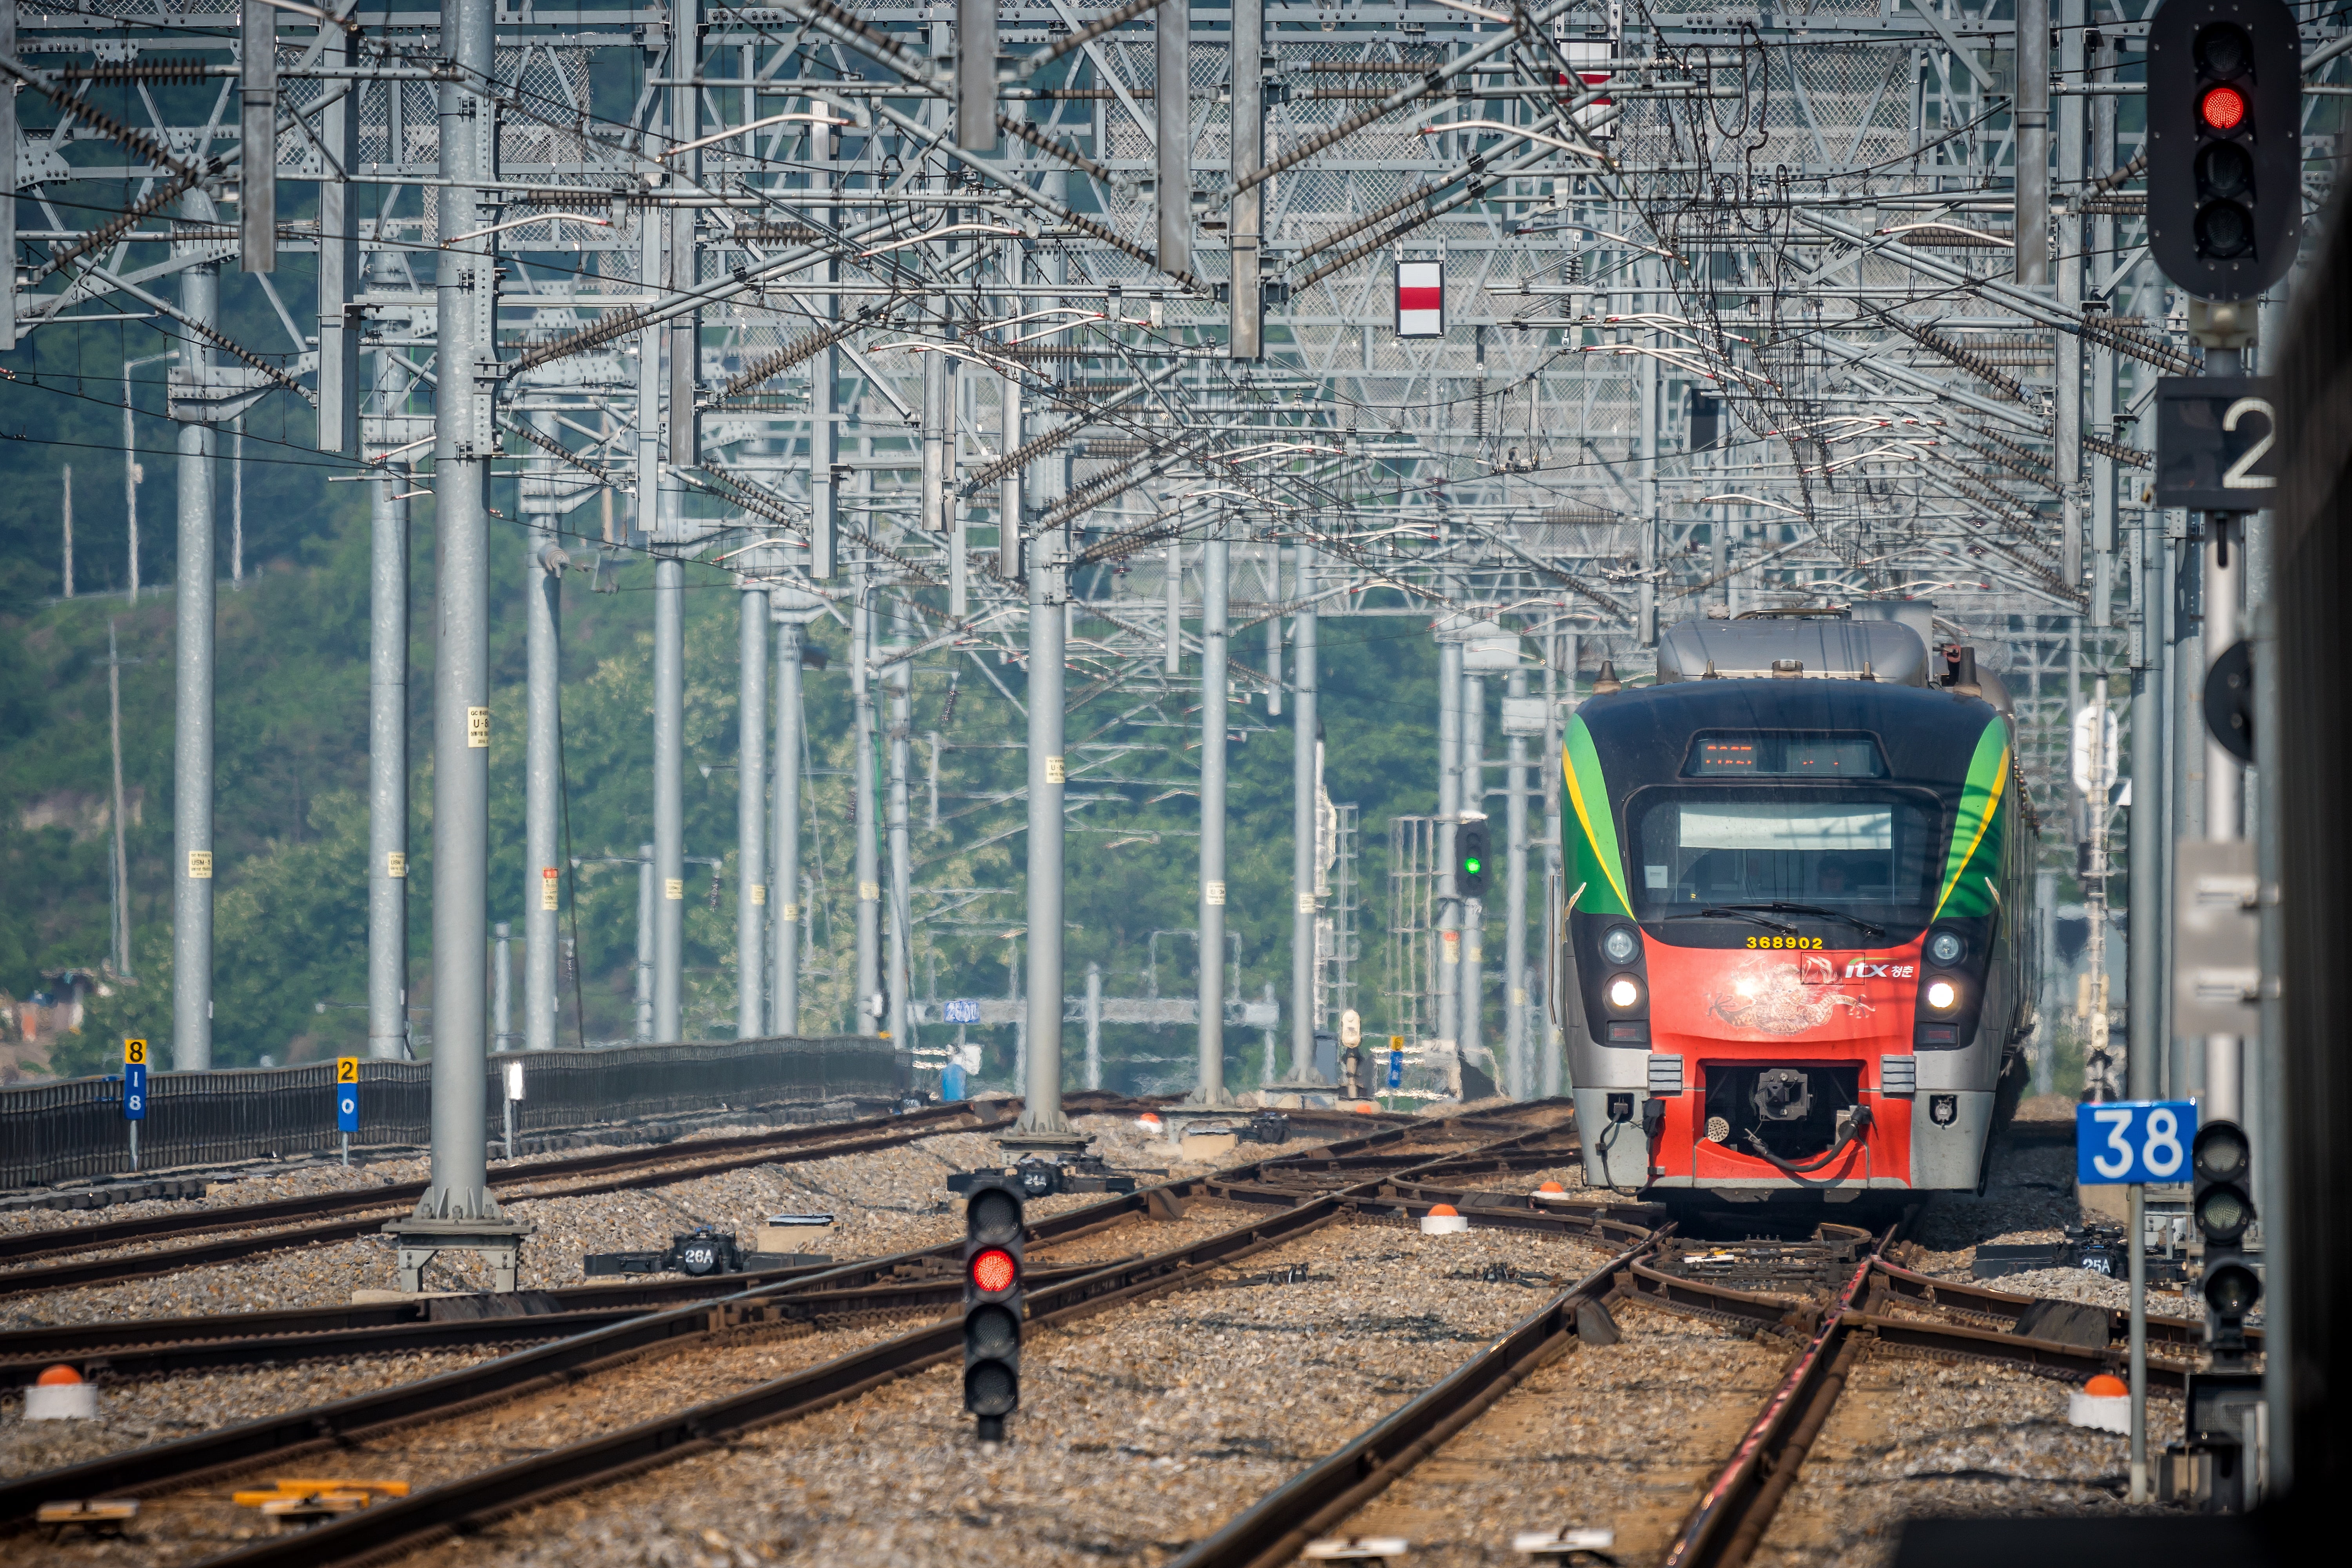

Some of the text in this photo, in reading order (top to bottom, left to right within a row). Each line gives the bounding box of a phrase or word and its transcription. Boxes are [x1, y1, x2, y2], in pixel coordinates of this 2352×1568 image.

[2223, 397, 2277, 488] 2
[1747, 936, 1822, 949] 368902
[1891, 965, 1914, 978] 청춘
[129, 1042, 143, 1062] 8
[341, 1061, 353, 1081] 2
[2093, 1108, 2183, 1178] 38
[685, 1249, 713, 1264] 26A
[2083, 1258, 2111, 1274] 25A
